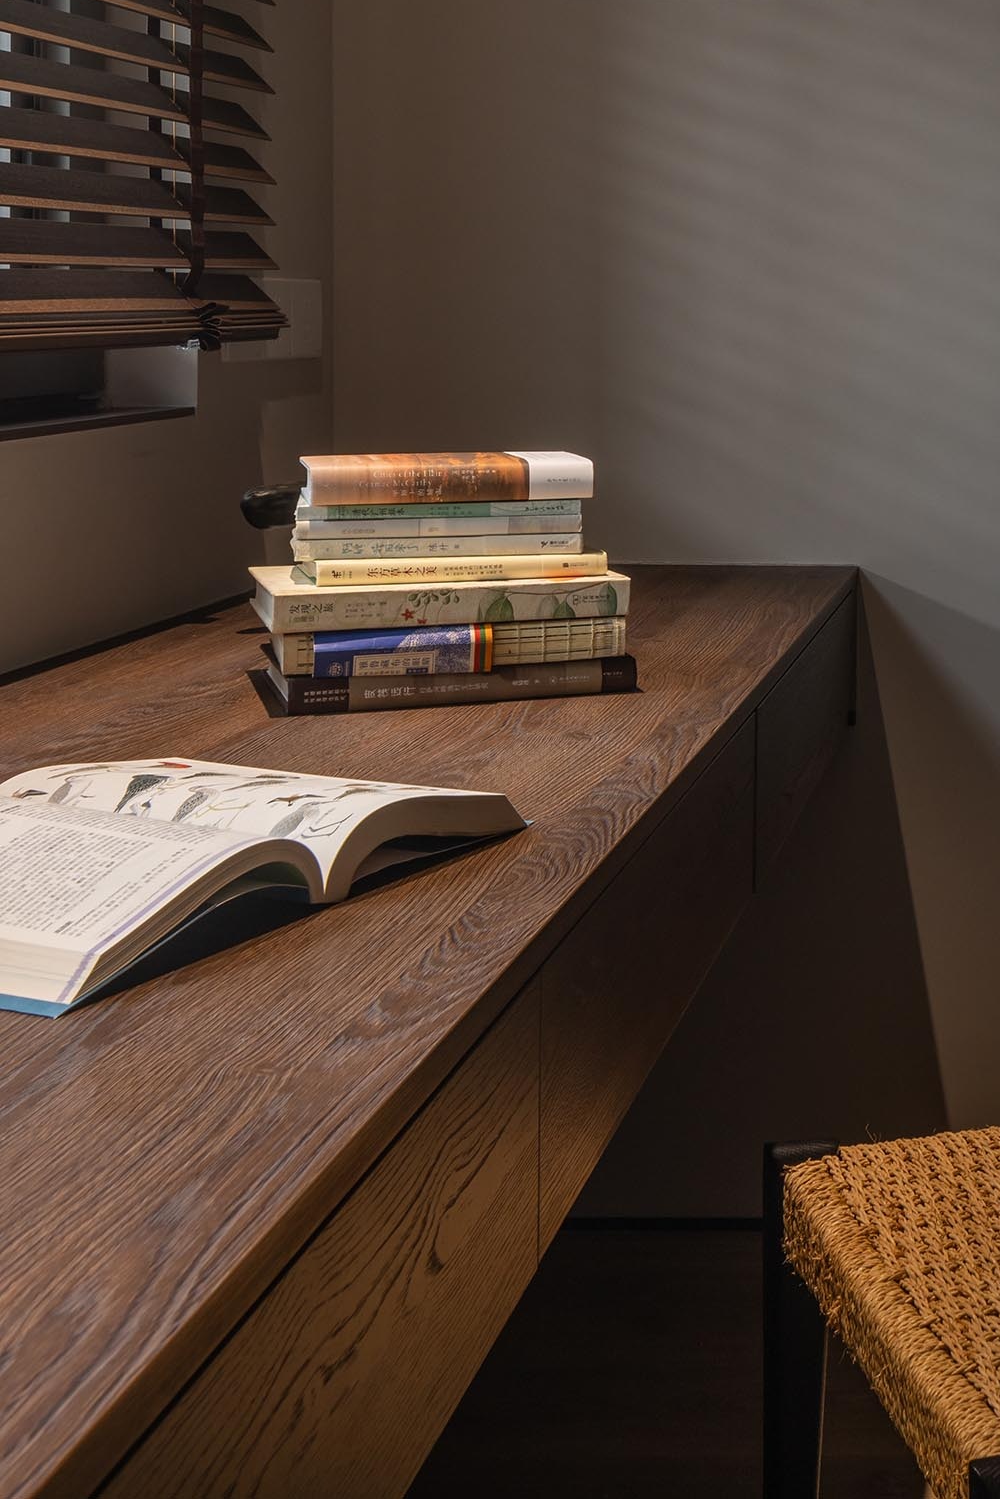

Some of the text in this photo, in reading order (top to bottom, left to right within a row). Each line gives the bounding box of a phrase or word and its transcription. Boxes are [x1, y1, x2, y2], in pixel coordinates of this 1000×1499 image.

[393, 478, 432, 487] McCarthy
[288, 603, 335, 615] 发现之旅
